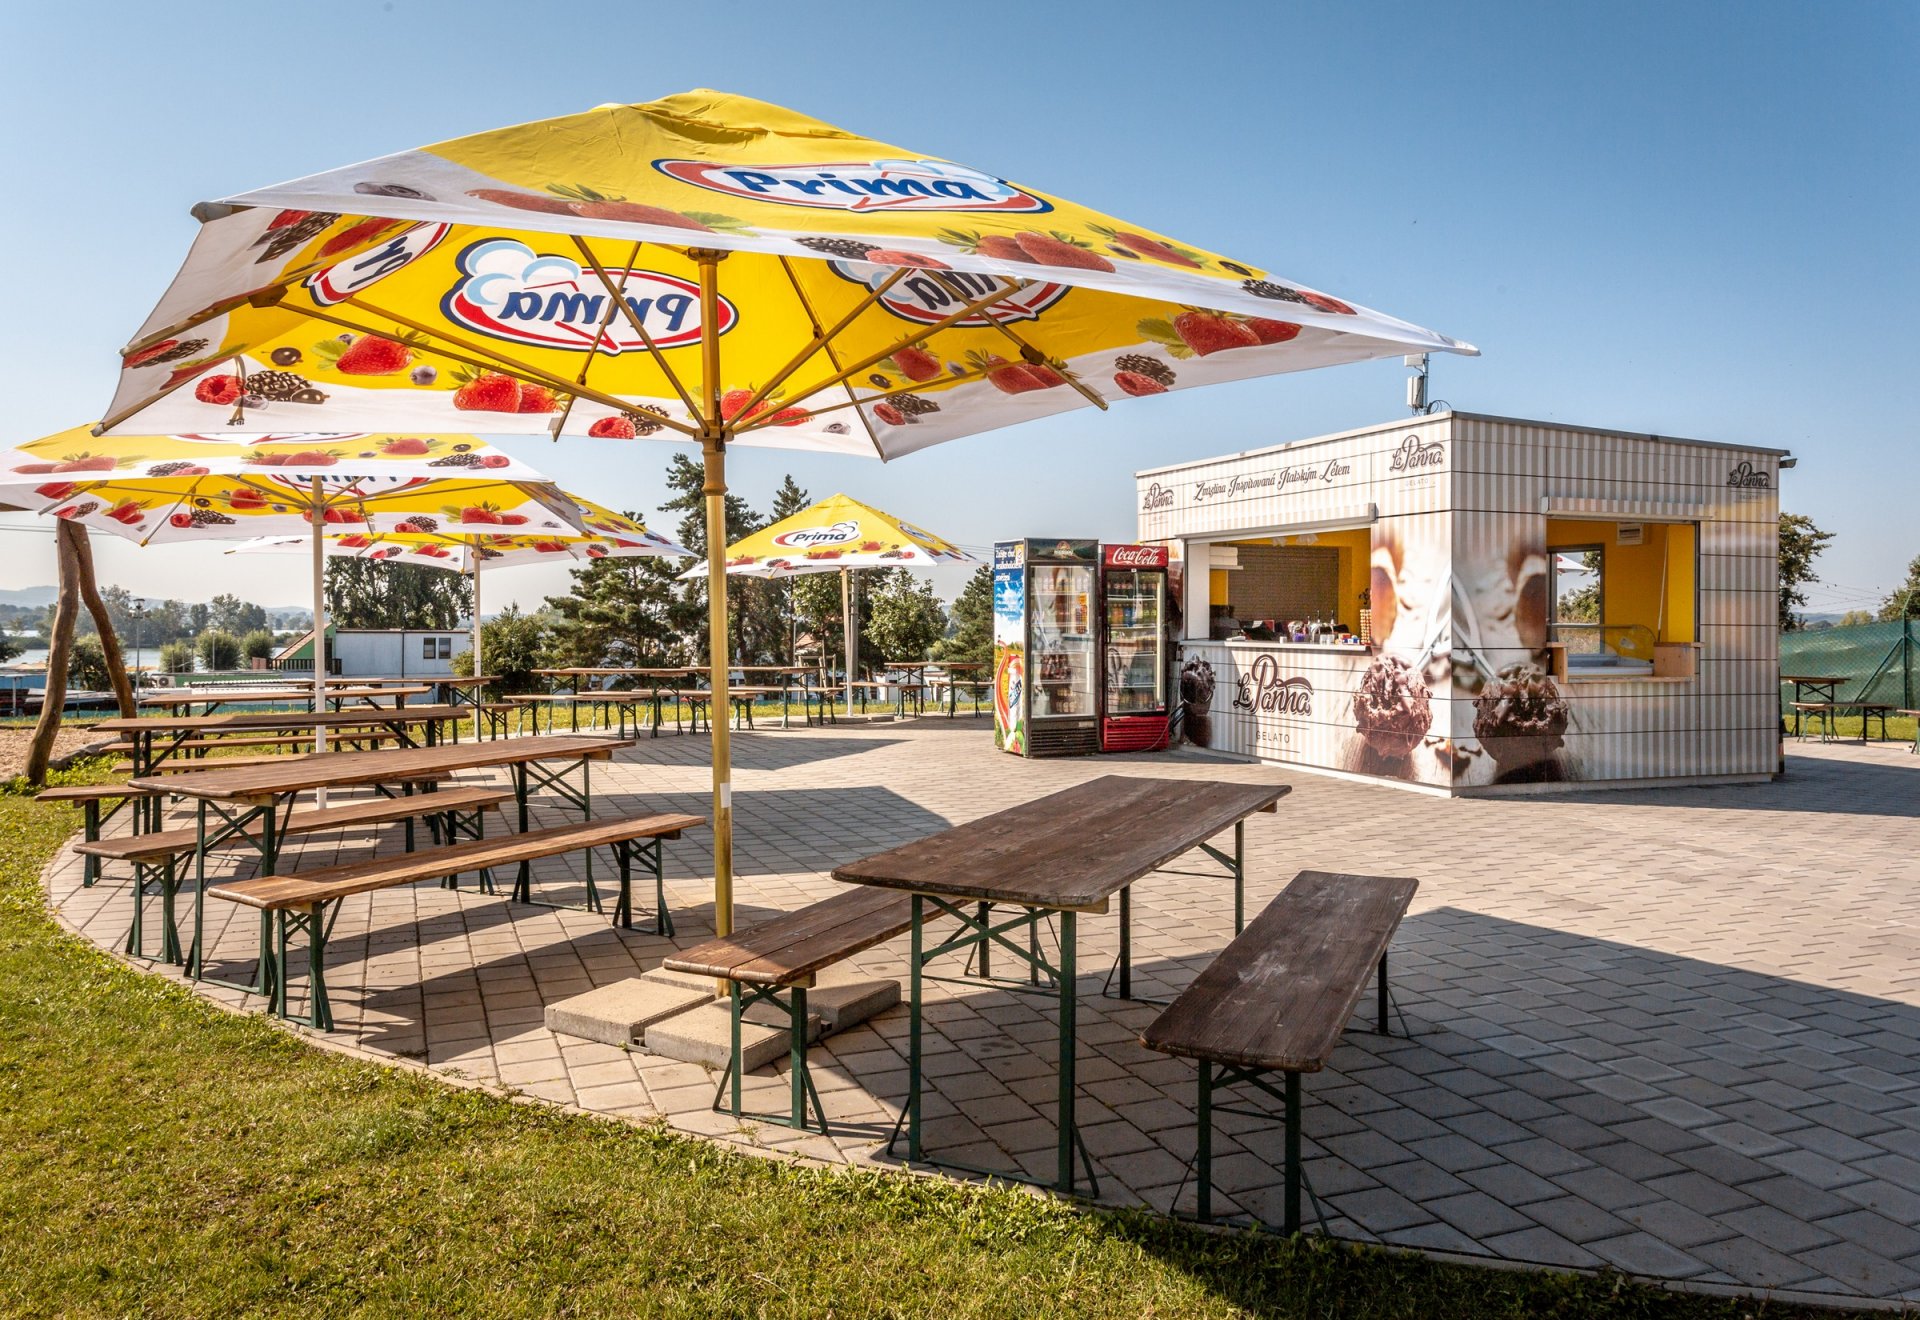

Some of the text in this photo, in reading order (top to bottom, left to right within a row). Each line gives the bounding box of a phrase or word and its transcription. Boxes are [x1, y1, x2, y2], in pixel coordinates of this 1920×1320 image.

[724, 171, 997, 202] Prima
[1389, 434, 1444, 472] La Panna
[1727, 461, 1769, 488] La Panna
[1150, 482, 1174, 511] Panna
[793, 531, 847, 543] Prima
[1112, 546, 1160, 565] Coca-Cola
[1233, 654, 1314, 716] La Panna
[1256, 730, 1290, 744] GELATO
